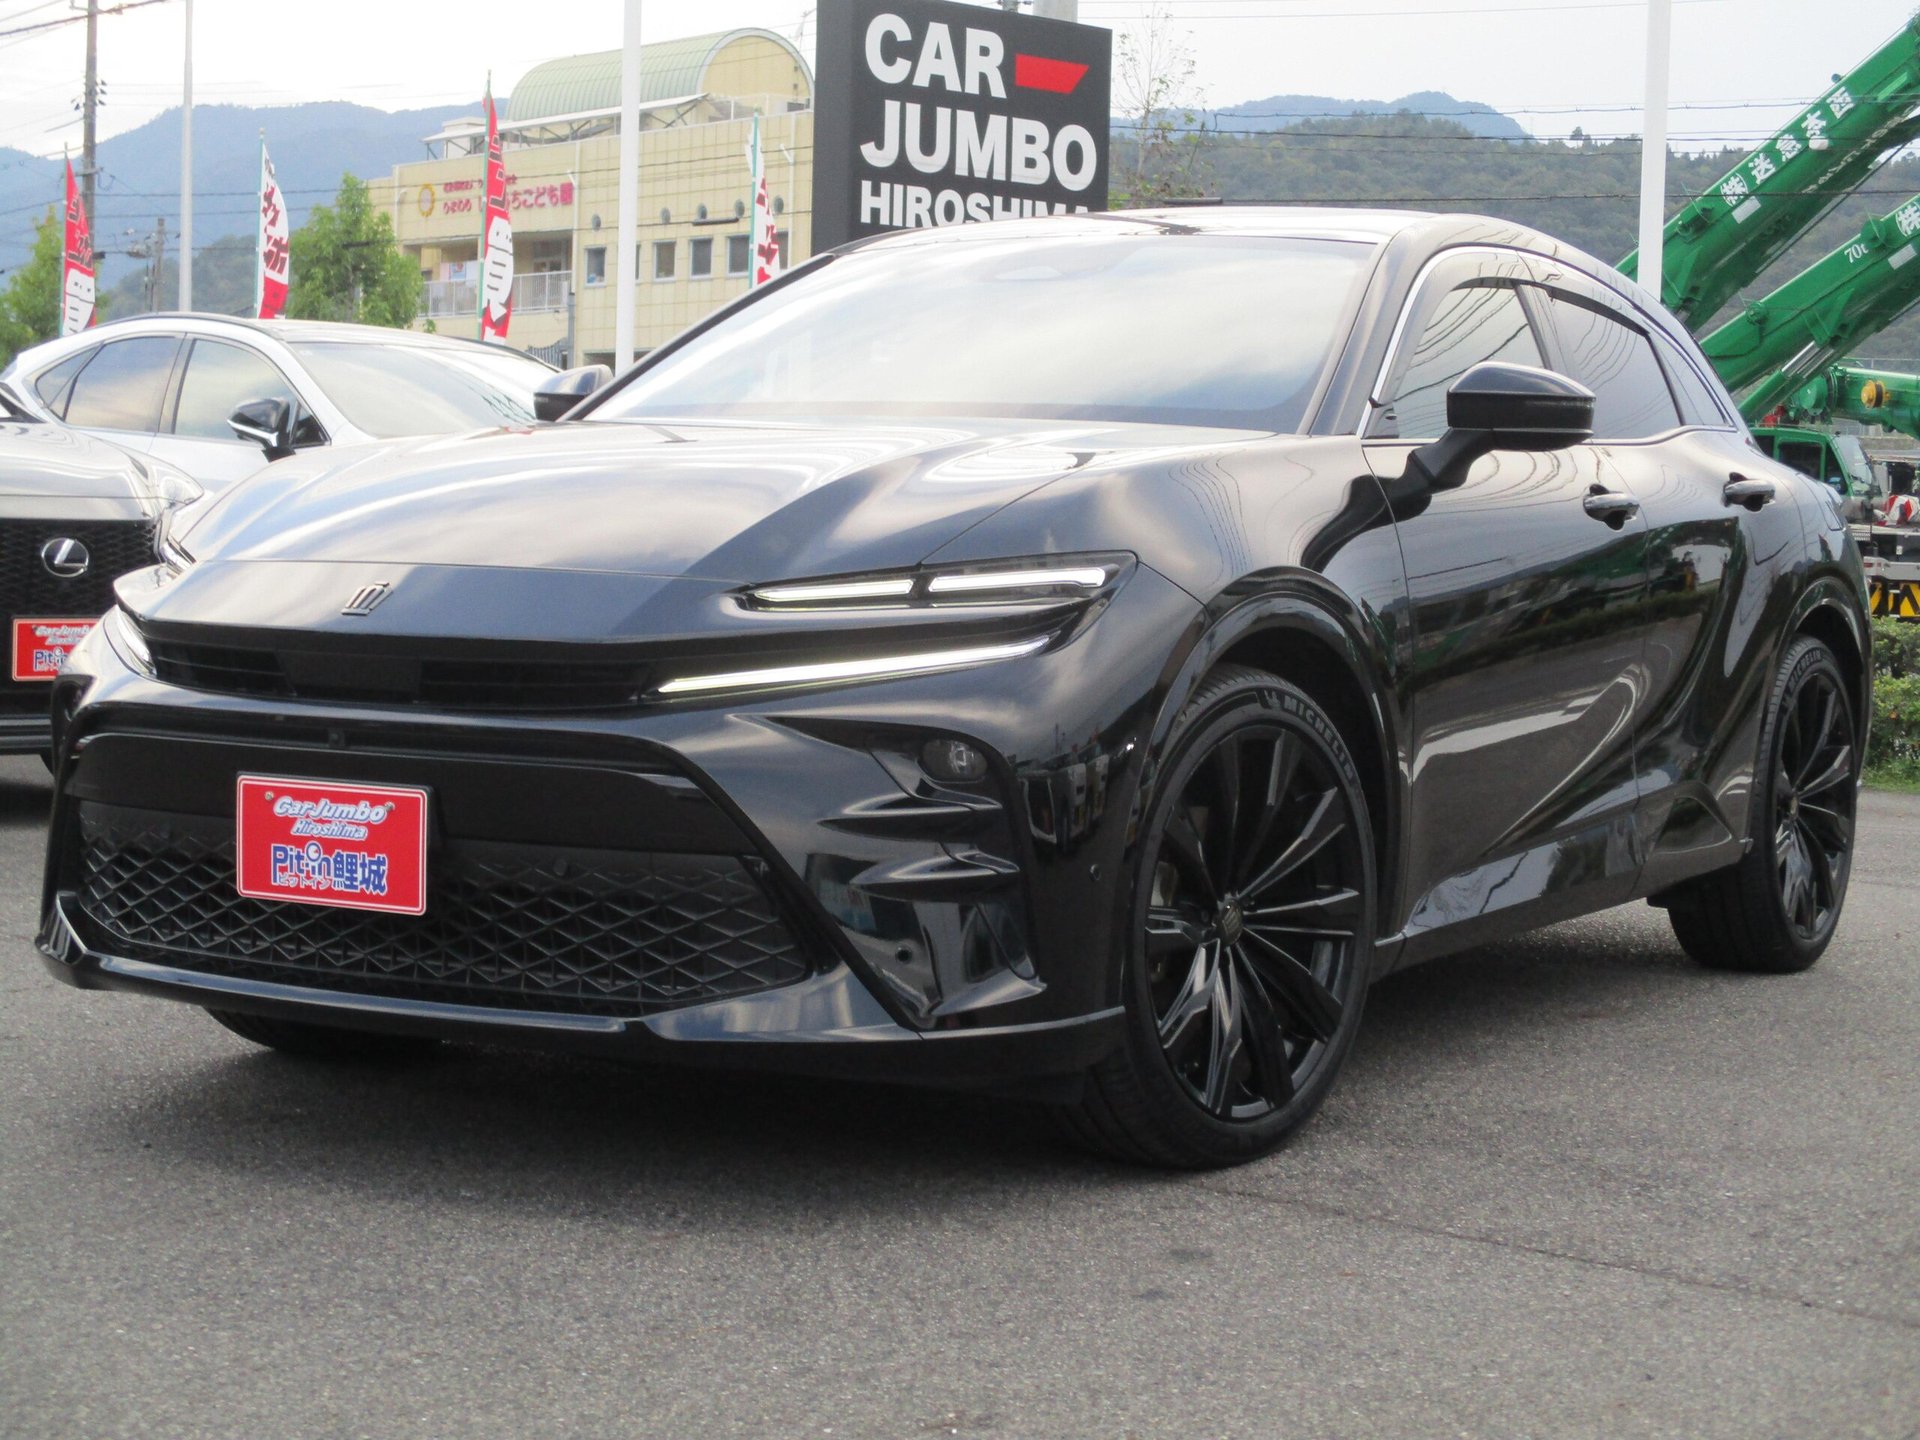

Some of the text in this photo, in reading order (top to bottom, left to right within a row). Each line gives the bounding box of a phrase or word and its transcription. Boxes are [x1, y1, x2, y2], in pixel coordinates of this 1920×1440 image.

[865, 13, 1007, 99] CAR
[860, 99, 1097, 192] JUMBO
[1844, 243, 1869, 263] 70t
[1283, 694, 1354, 780] MICHELIN
[291, 818, 368, 841] Hiroshima
